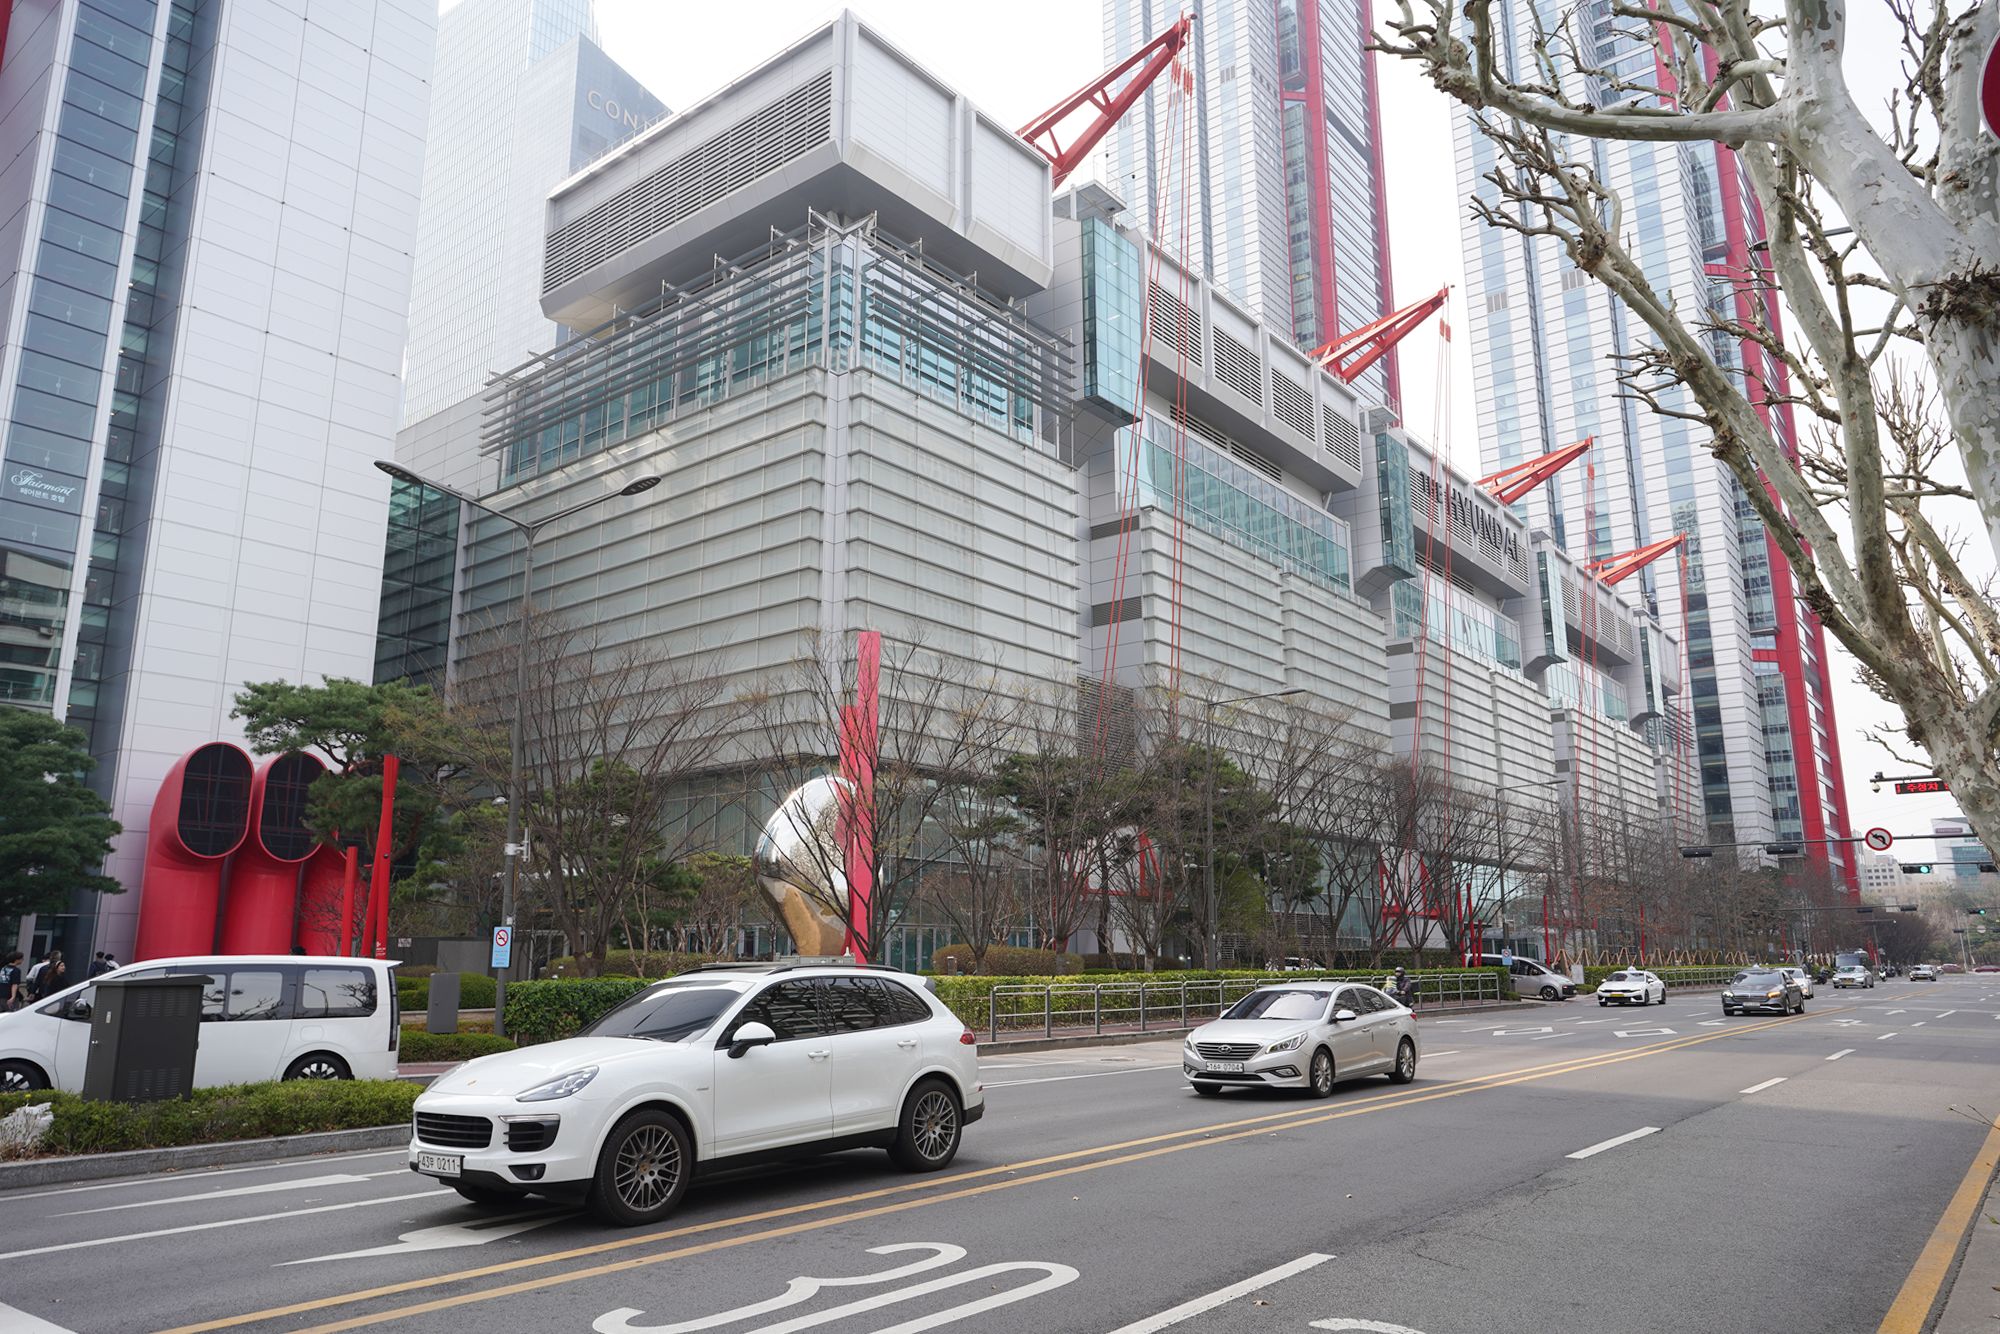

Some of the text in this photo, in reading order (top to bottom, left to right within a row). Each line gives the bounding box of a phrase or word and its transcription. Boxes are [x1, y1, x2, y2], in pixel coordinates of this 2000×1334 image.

[10, 469, 76, 496] Fairmont
[20, 487, 65, 503] 페어몬트 호텔
[1420, 471, 1519, 562] THE HYUNDAI
[436, 1157, 456, 1172] 0211
